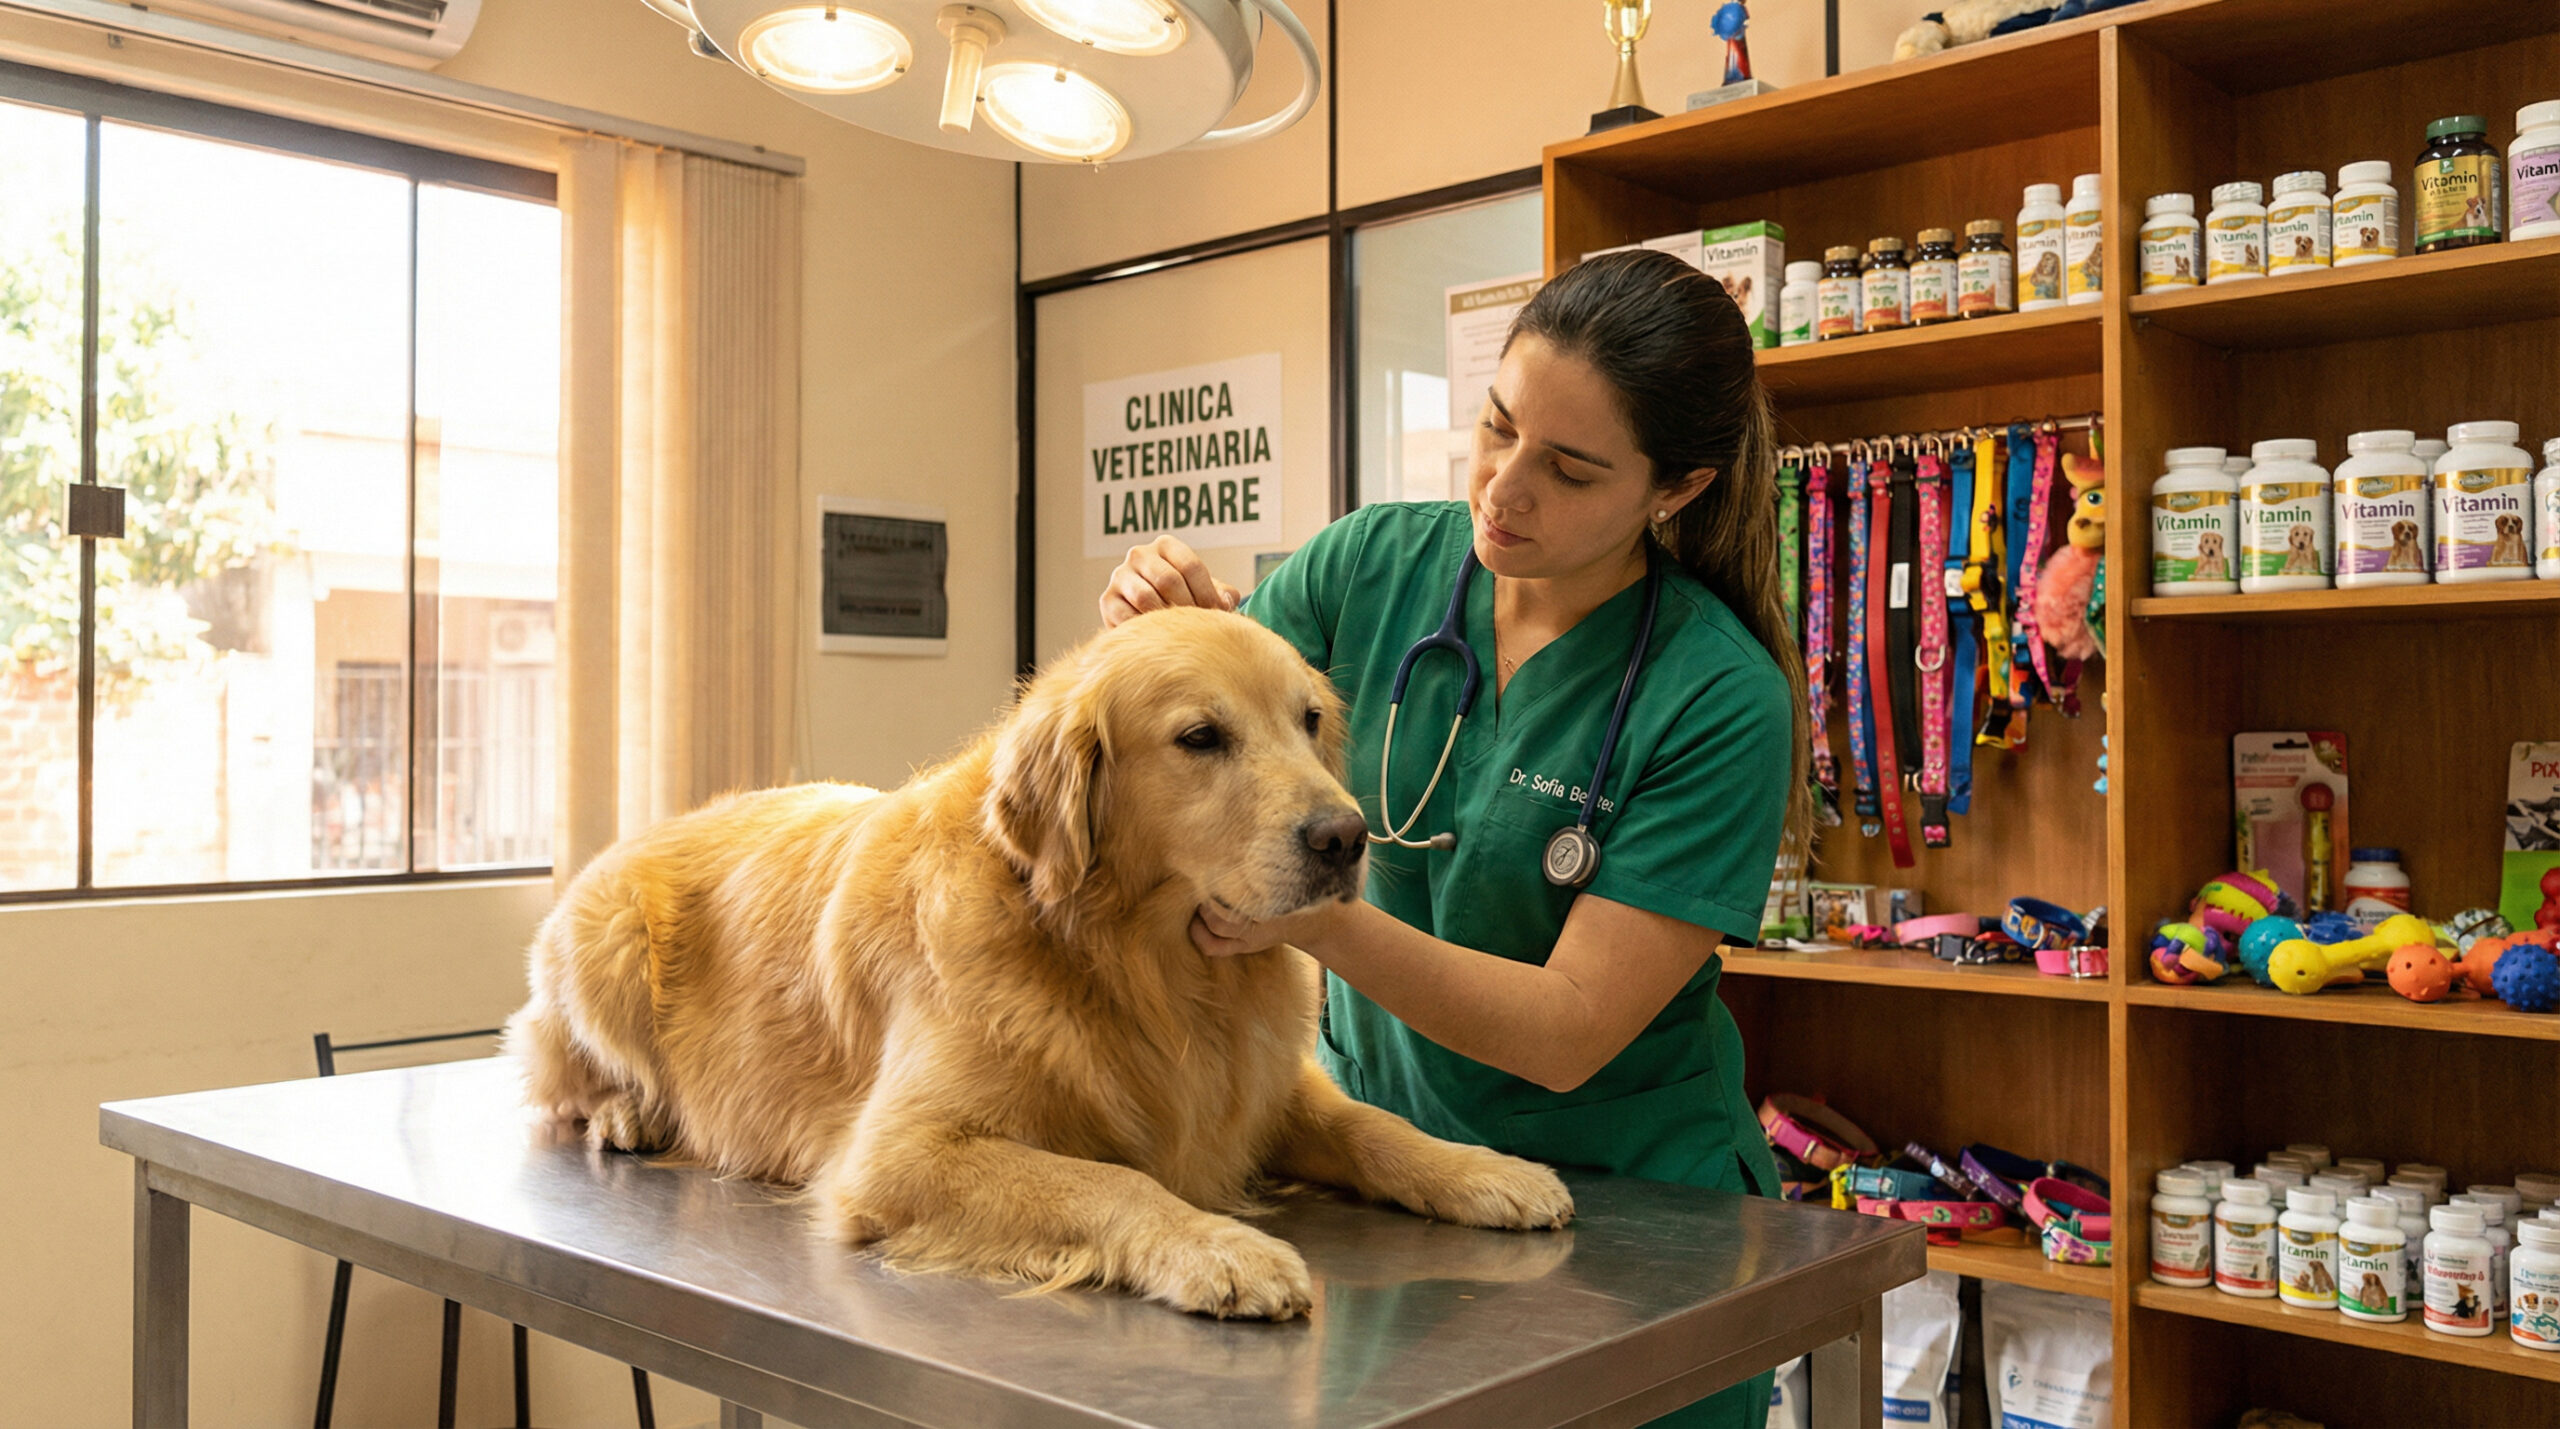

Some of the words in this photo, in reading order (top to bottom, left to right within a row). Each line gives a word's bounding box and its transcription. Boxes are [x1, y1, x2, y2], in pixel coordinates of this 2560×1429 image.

[2421, 171, 2478, 191] Vitamin
[1706, 243, 1759, 263] Vitamin
[1126, 382, 1233, 432] CLINICA
[1092, 426, 1271, 482] VETERINARIA
[1104, 477, 1260, 535] LAMBARE
[2244, 506, 2312, 525] Vtamin
[2342, 500, 2415, 520] Vitamin
[2156, 514, 2221, 532] Vitamin
[1509, 768, 1527, 787] Dr.
[1531, 774, 1565, 798] Sofia
